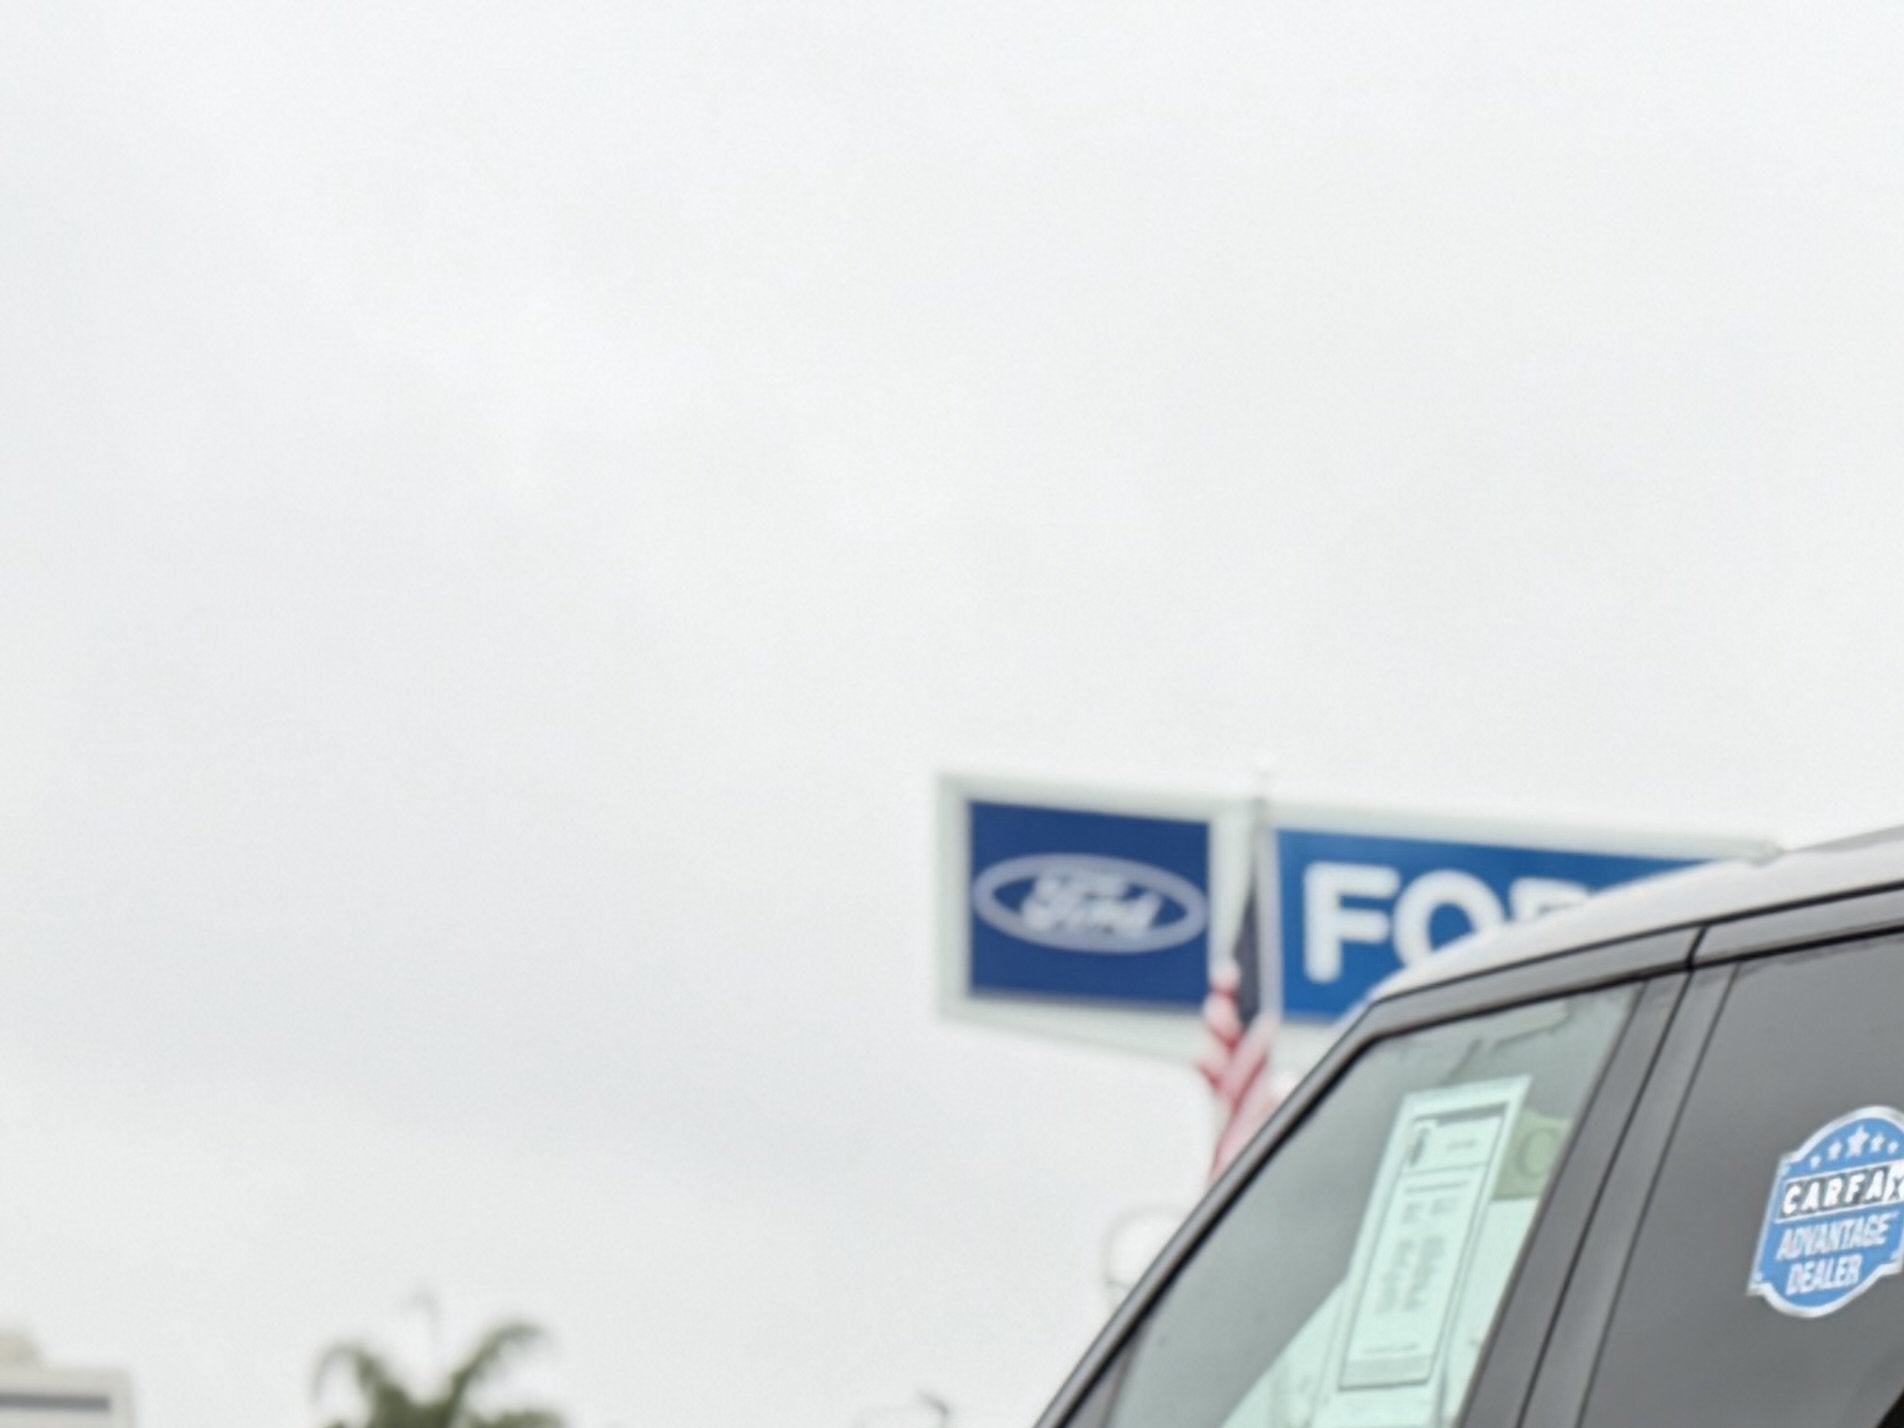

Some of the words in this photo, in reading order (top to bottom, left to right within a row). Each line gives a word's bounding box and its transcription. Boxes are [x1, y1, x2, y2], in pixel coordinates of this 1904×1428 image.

[1303, 861, 1592, 984] FO
[1776, 1213, 1896, 1261] ADVANTAGE
[1786, 1253, 1863, 1295] DEALER
